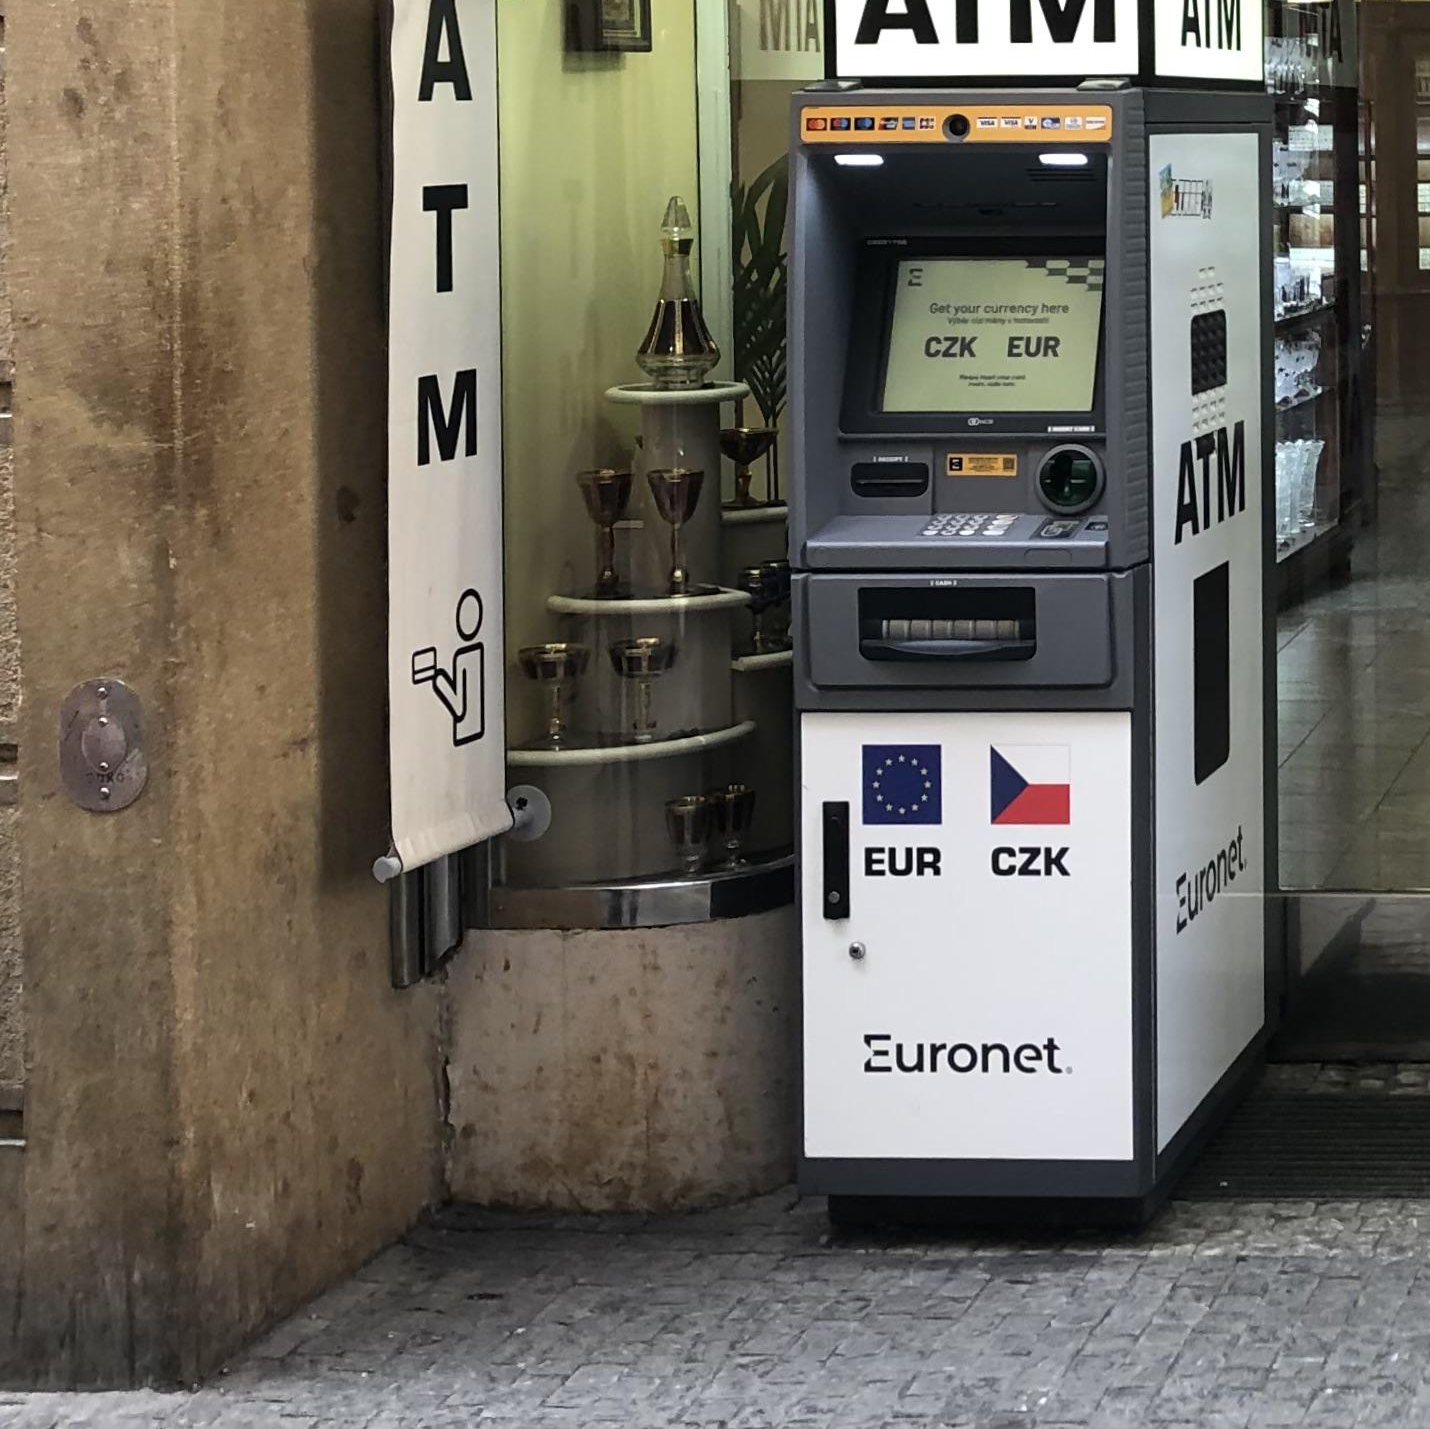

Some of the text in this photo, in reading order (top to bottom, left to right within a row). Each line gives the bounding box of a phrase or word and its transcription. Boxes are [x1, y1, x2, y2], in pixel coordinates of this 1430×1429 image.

[929, 302, 1069, 317] Get your currency here
[924, 335, 1060, 358] CZK EUR
[1174, 419, 1246, 546] ATM
[864, 847, 1071, 877] EUR CZK
[1175, 824, 1244, 936] Euronet
[863, 1033, 1063, 1074] Euronet
